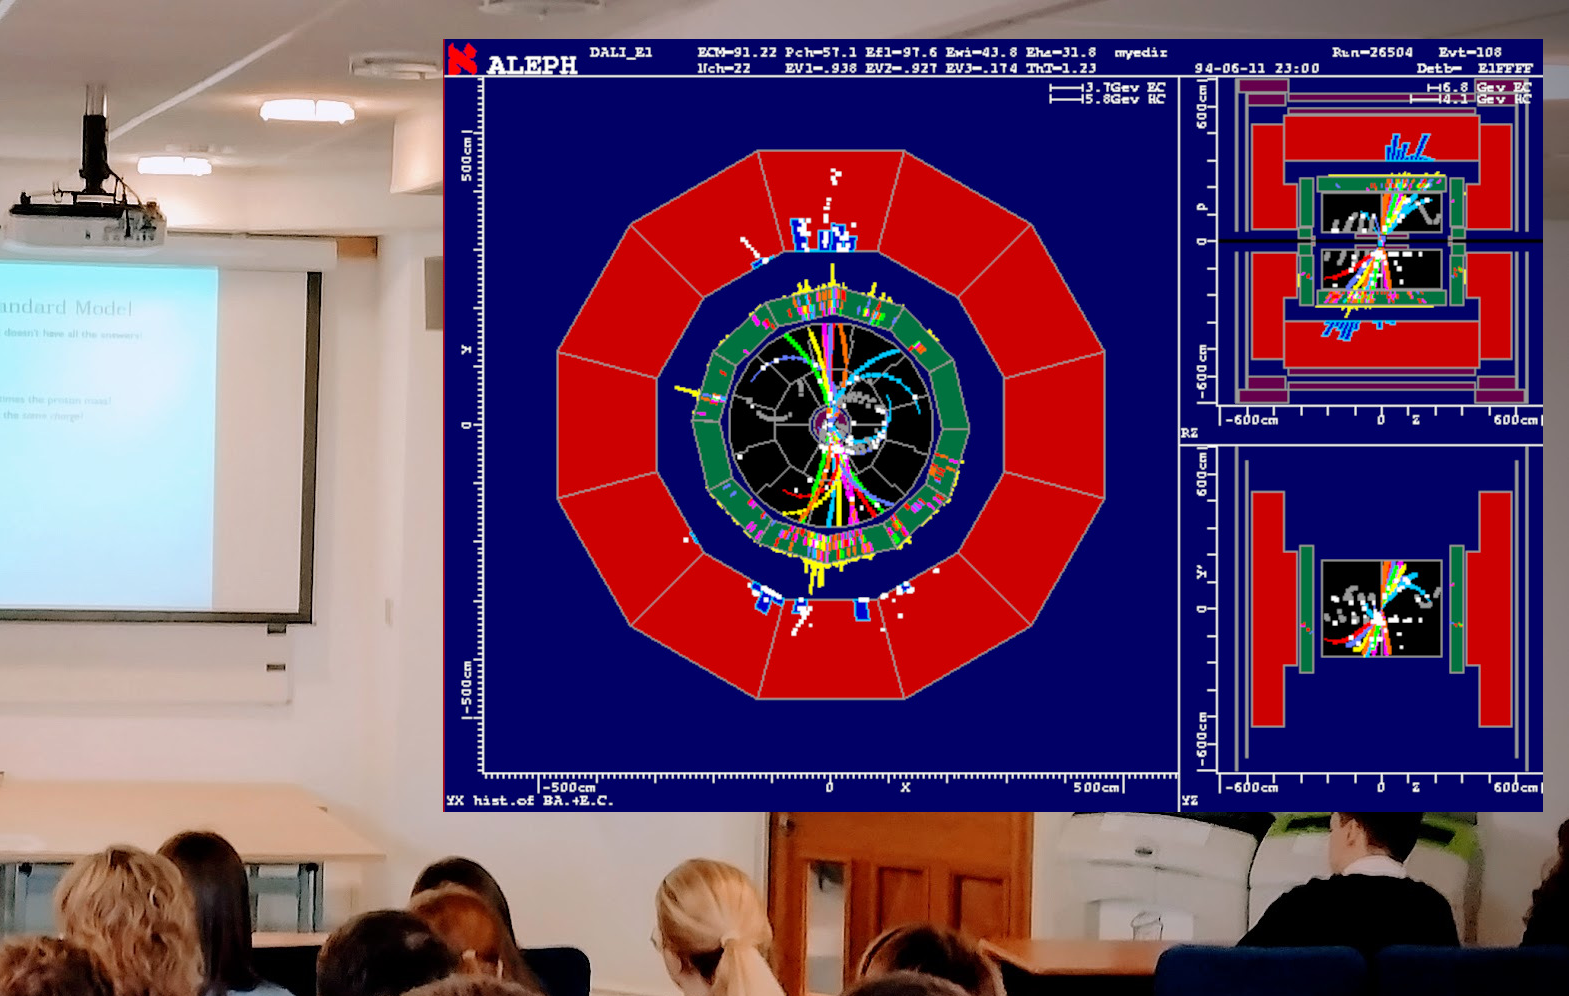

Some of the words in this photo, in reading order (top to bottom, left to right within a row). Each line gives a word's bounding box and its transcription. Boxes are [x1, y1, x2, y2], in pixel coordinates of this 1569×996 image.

[76, 300, 133, 316] Model
[3, 328, 39, 338] doesn't
[42, 329, 64, 338] have
[67, 329, 79, 338] all
[81, 330, 98, 339] the
[28, 395, 44, 405] the
[46, 396, 81, 406] proton
[3, 410, 19, 420] the
